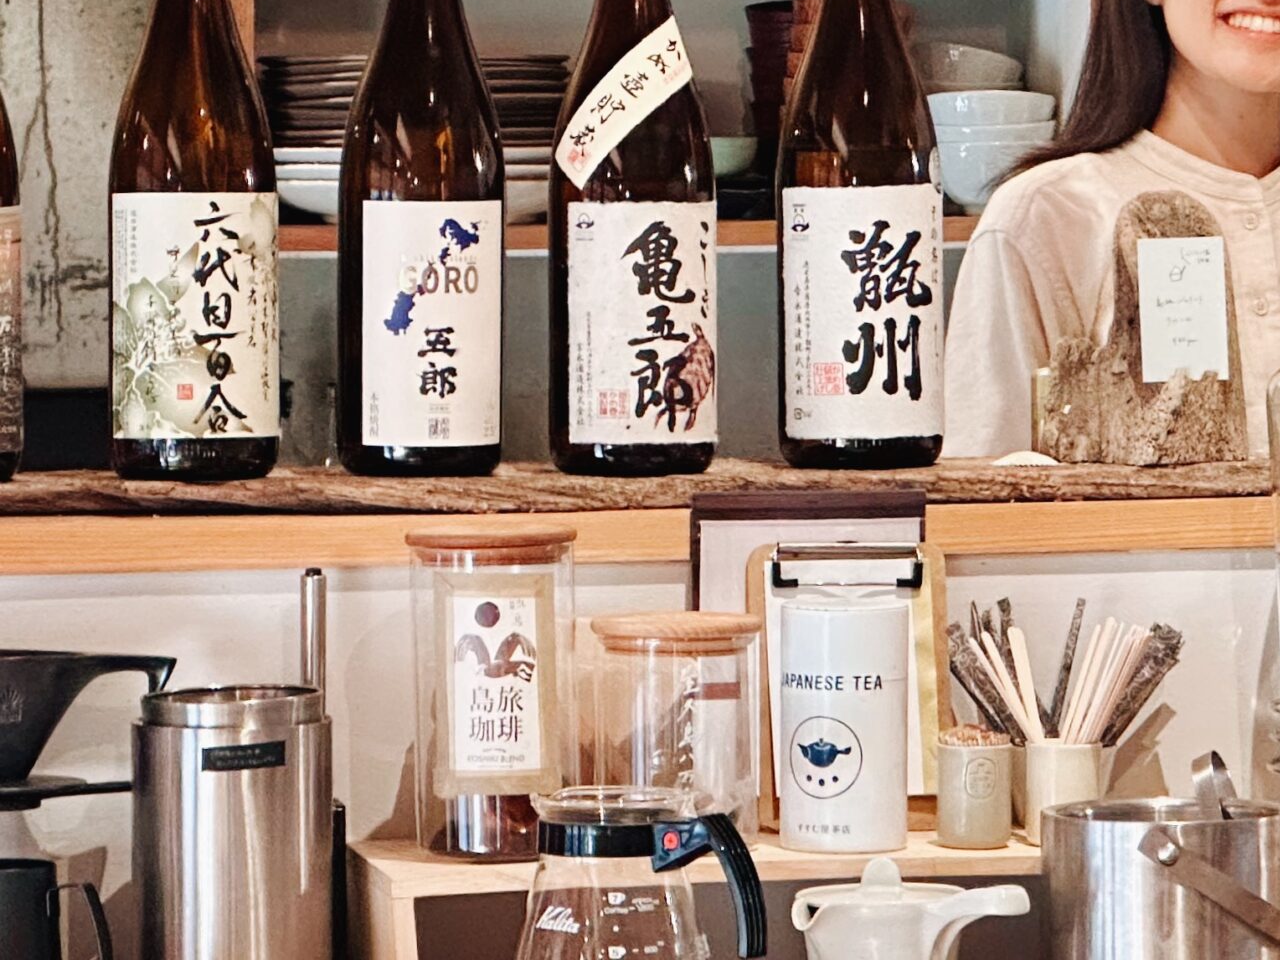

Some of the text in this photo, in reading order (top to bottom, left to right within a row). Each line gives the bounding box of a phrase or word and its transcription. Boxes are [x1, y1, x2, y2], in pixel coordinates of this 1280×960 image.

[193, 201, 248, 434] 六代目百合
[620, 220, 696, 433] 亀五郎
[841, 220, 933, 401] 甑州
[417, 327, 458, 399] 五郎
[470, 686, 523, 713] 島旅
[782, 672, 883, 691] JAPANESE TEA
[469, 716, 523, 742] 珈琲
[536, 905, 581, 934] Kalita
